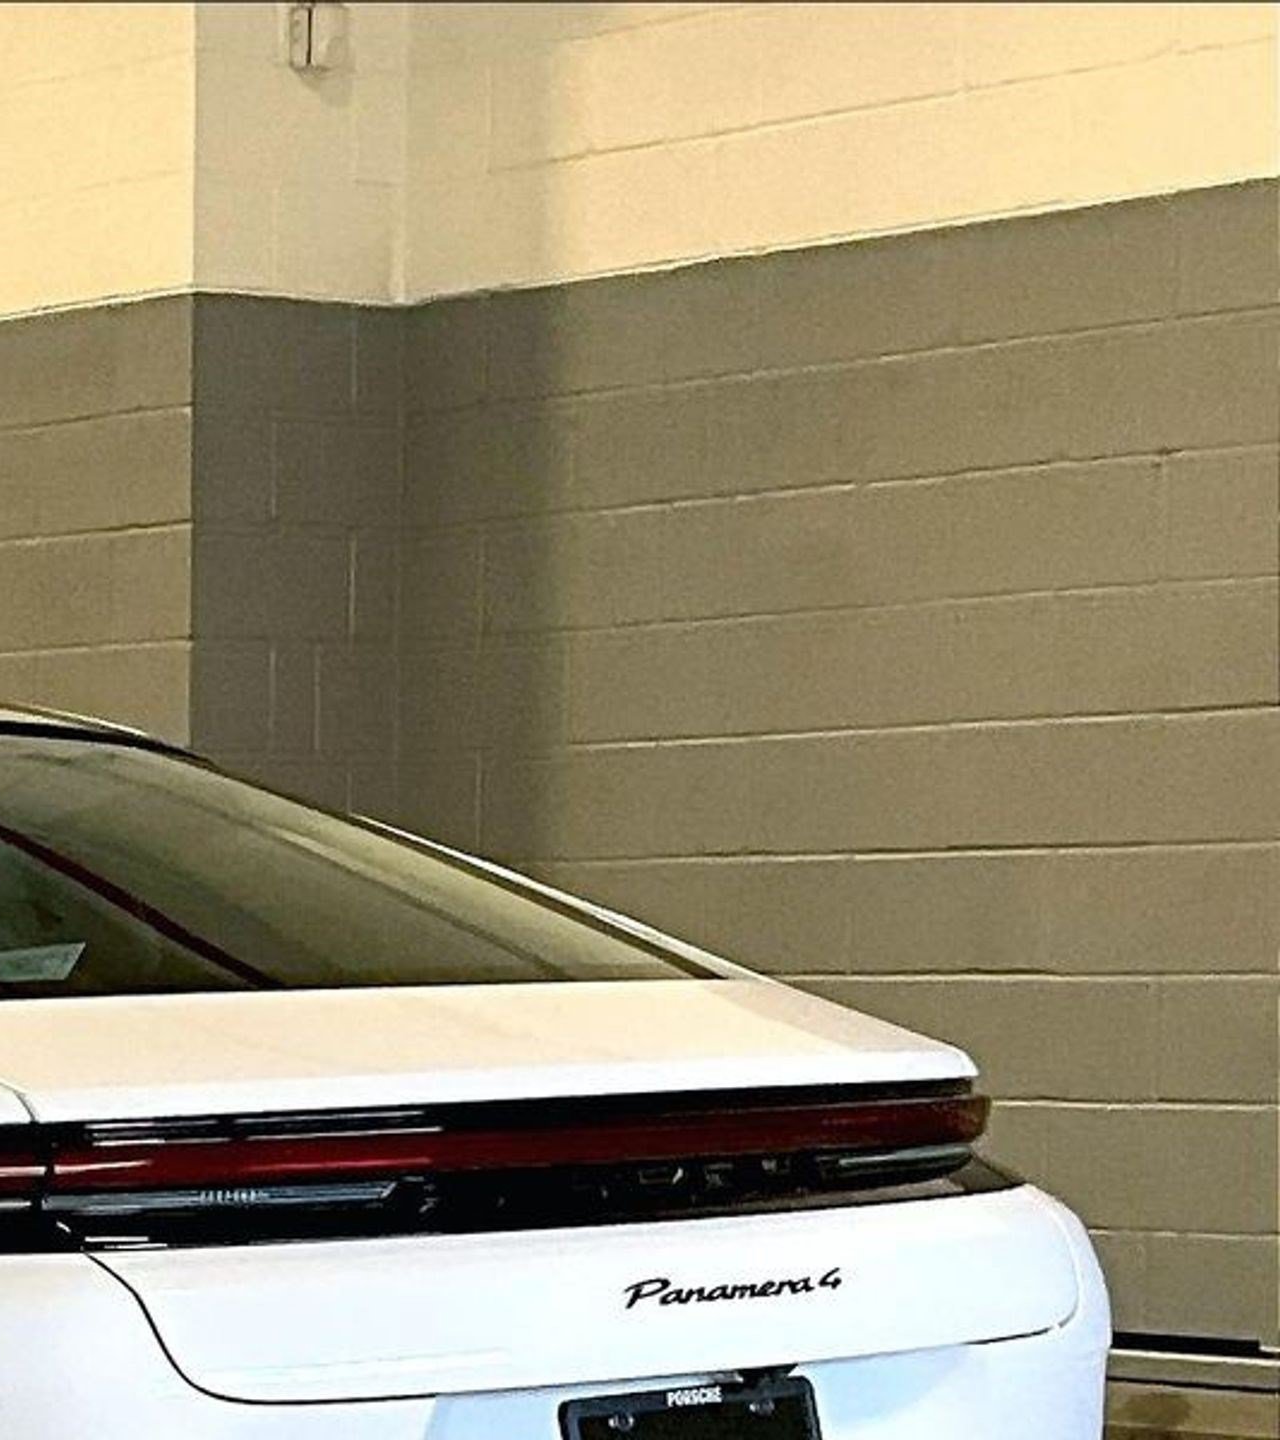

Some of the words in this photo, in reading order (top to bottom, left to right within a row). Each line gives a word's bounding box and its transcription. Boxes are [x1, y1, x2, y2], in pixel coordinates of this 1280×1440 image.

[624, 1277, 816, 1309] Panamera
[818, 1267, 843, 1289] 4
[667, 1386, 723, 1407] PORSCHE
